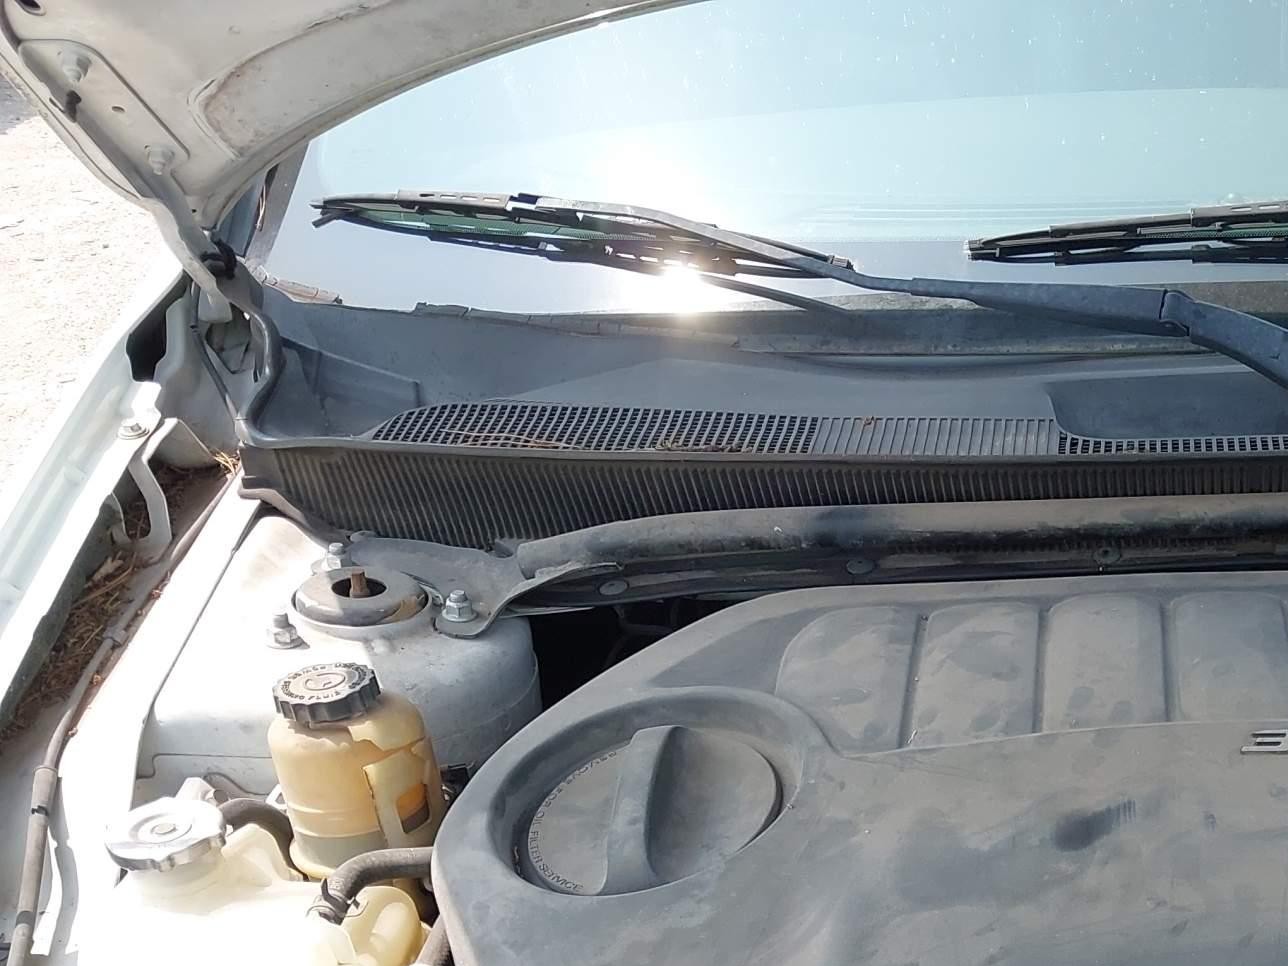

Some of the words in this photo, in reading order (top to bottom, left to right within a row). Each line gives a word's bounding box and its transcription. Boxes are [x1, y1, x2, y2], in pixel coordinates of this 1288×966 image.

[533, 811, 545, 826] OIL
[529, 830, 544, 865] FILTER
[539, 863, 584, 892] SERVICE
